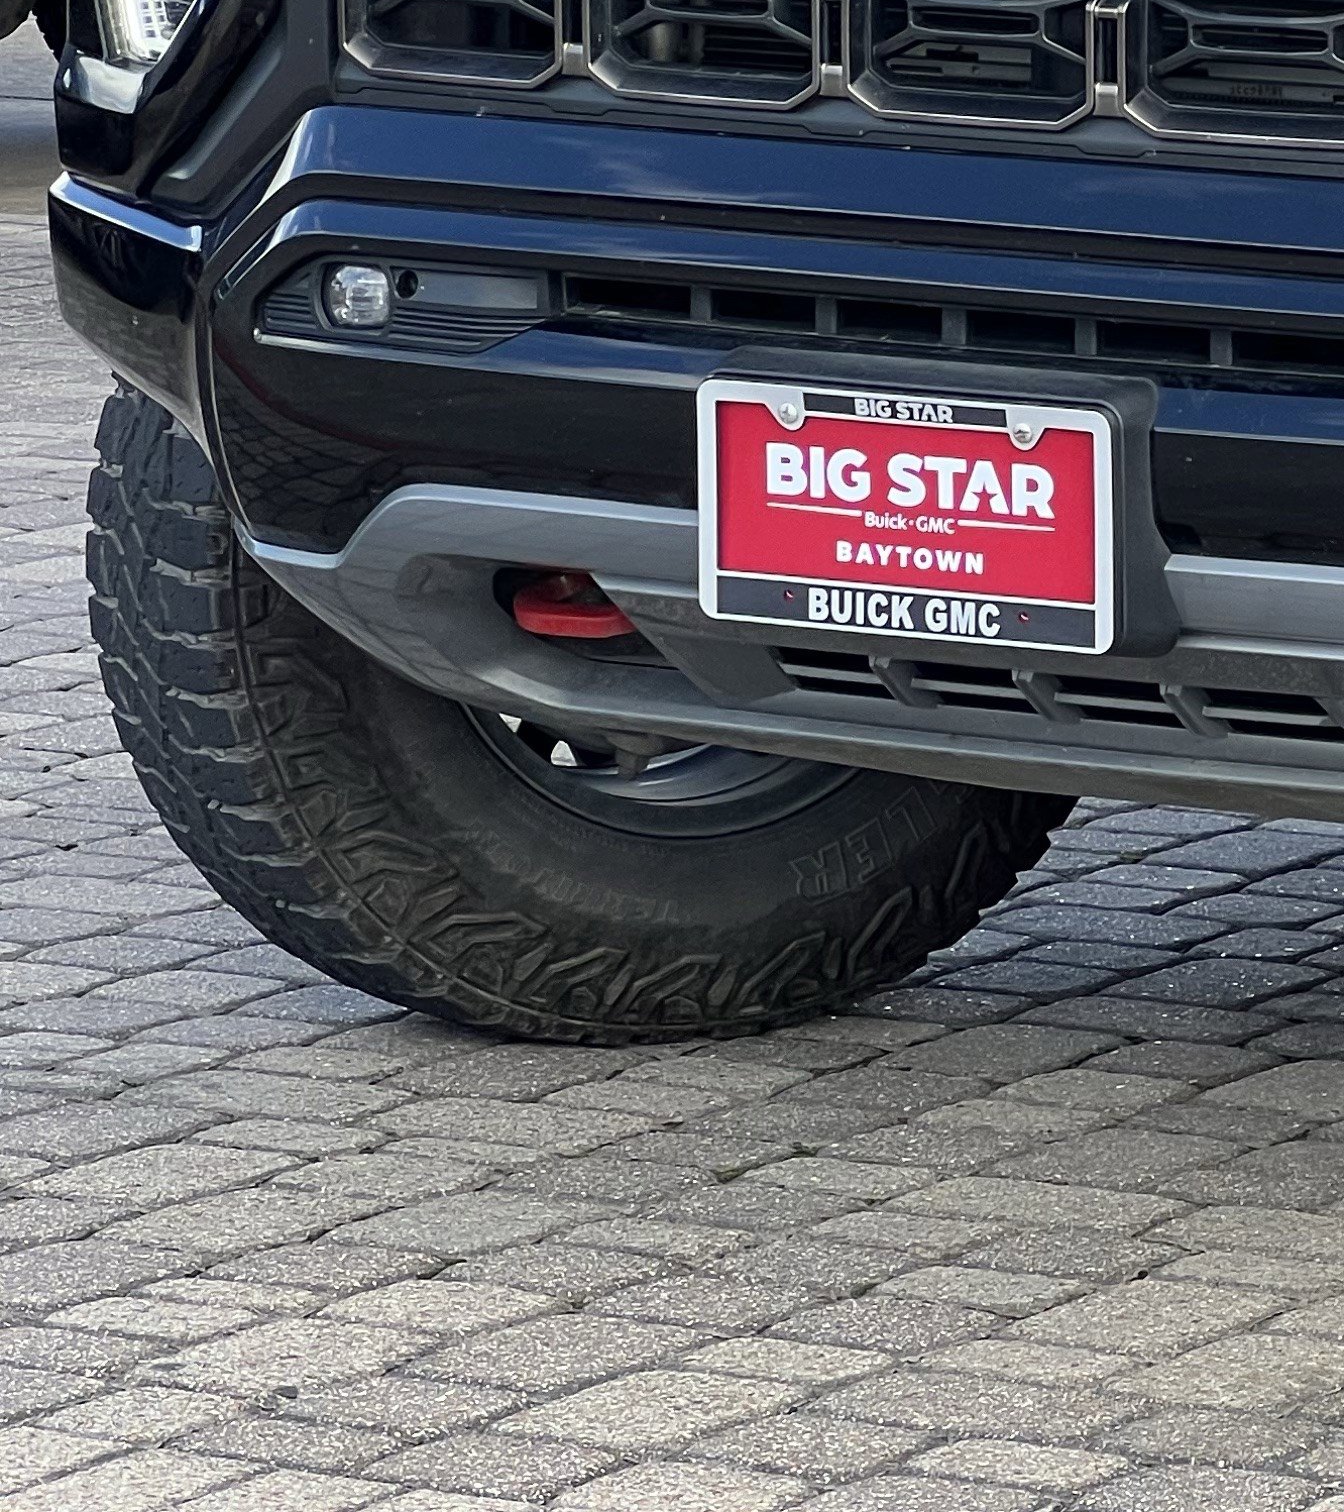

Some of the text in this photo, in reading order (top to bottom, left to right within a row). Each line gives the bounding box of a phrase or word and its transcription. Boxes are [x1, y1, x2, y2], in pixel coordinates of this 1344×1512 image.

[854, 397, 954, 424] BIG STAR
[764, 440, 1056, 520] BIG STAR
[863, 510, 956, 535] Buick GMC
[835, 539, 985, 576] BAYTOWN
[807, 586, 1002, 638] BUICK GMC
